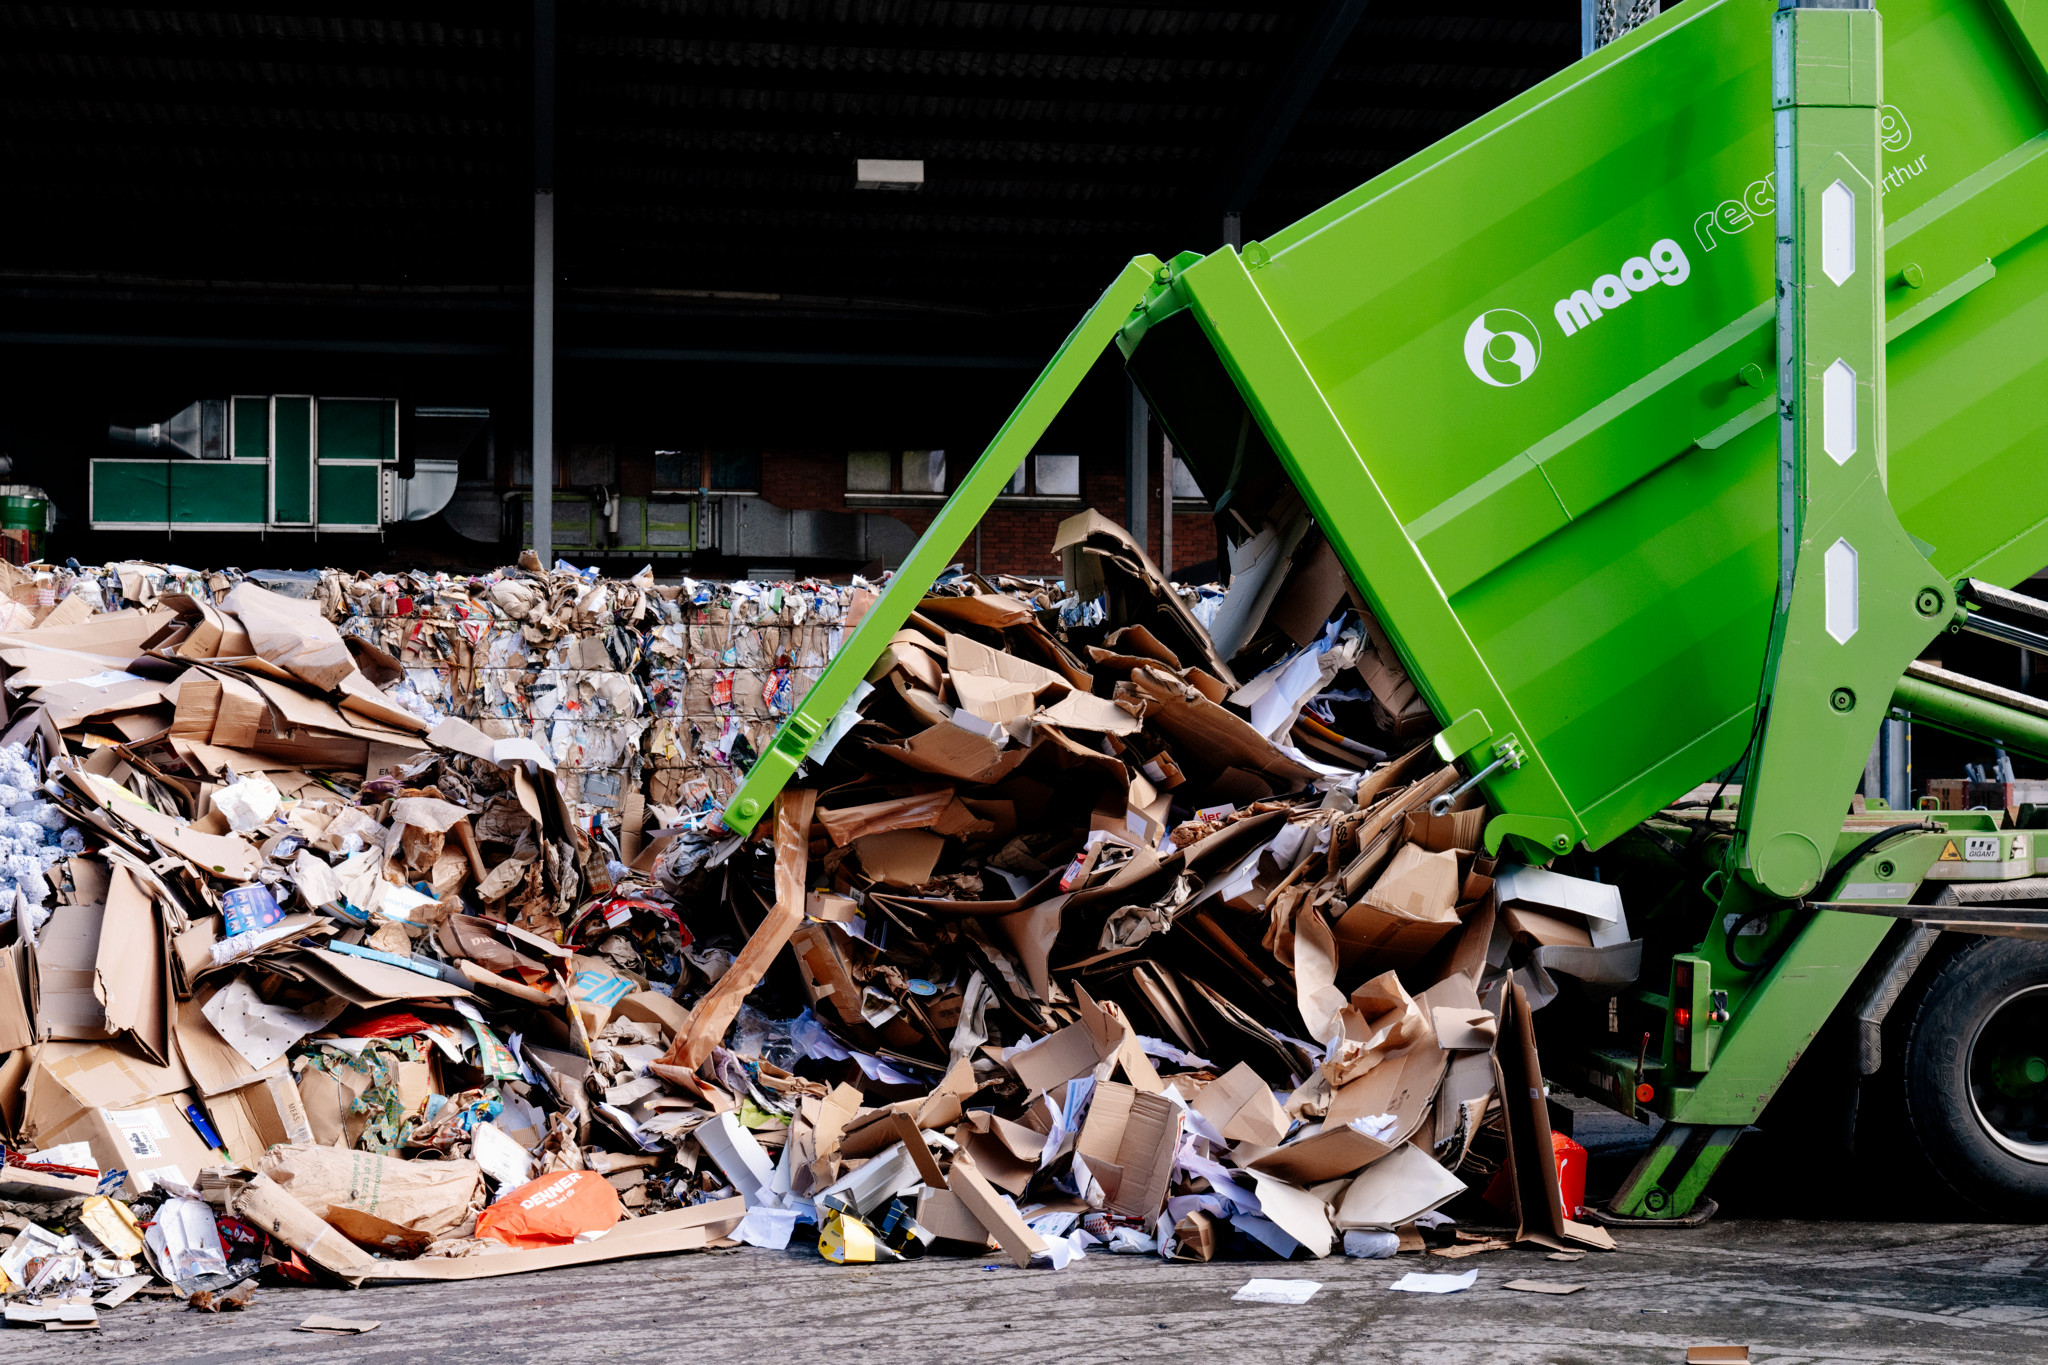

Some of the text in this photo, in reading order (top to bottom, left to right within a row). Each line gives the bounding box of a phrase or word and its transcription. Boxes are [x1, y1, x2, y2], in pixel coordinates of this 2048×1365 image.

[1882, 154, 1928, 195] rthur
[1553, 238, 1691, 337] maag
[519, 1172, 583, 1210] DENNER
